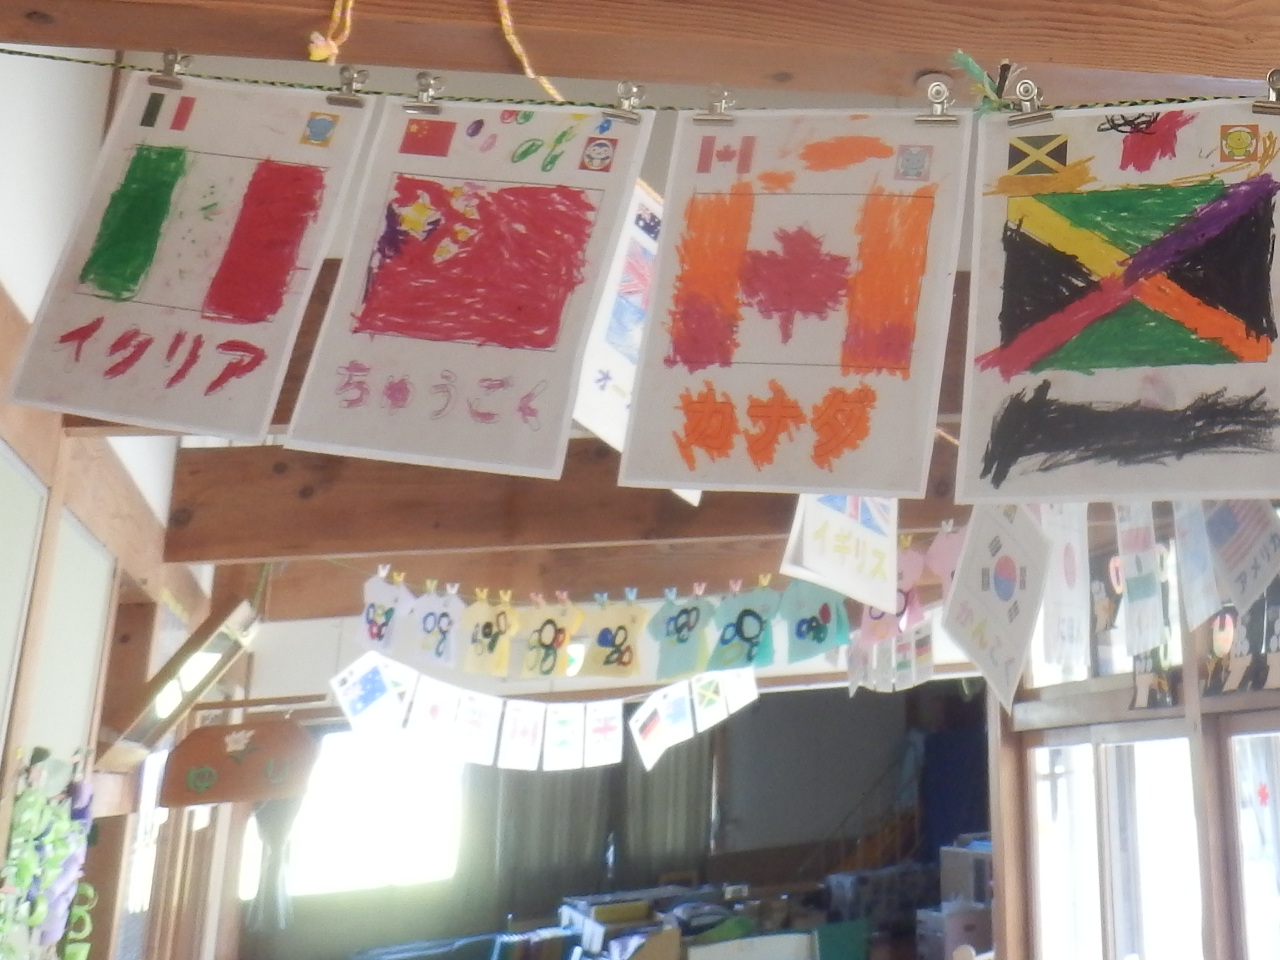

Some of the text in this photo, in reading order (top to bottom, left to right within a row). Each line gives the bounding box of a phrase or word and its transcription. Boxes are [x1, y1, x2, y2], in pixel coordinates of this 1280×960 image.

[672, 379, 878, 473] カナダ
[811, 520, 889, 583] イギリス
